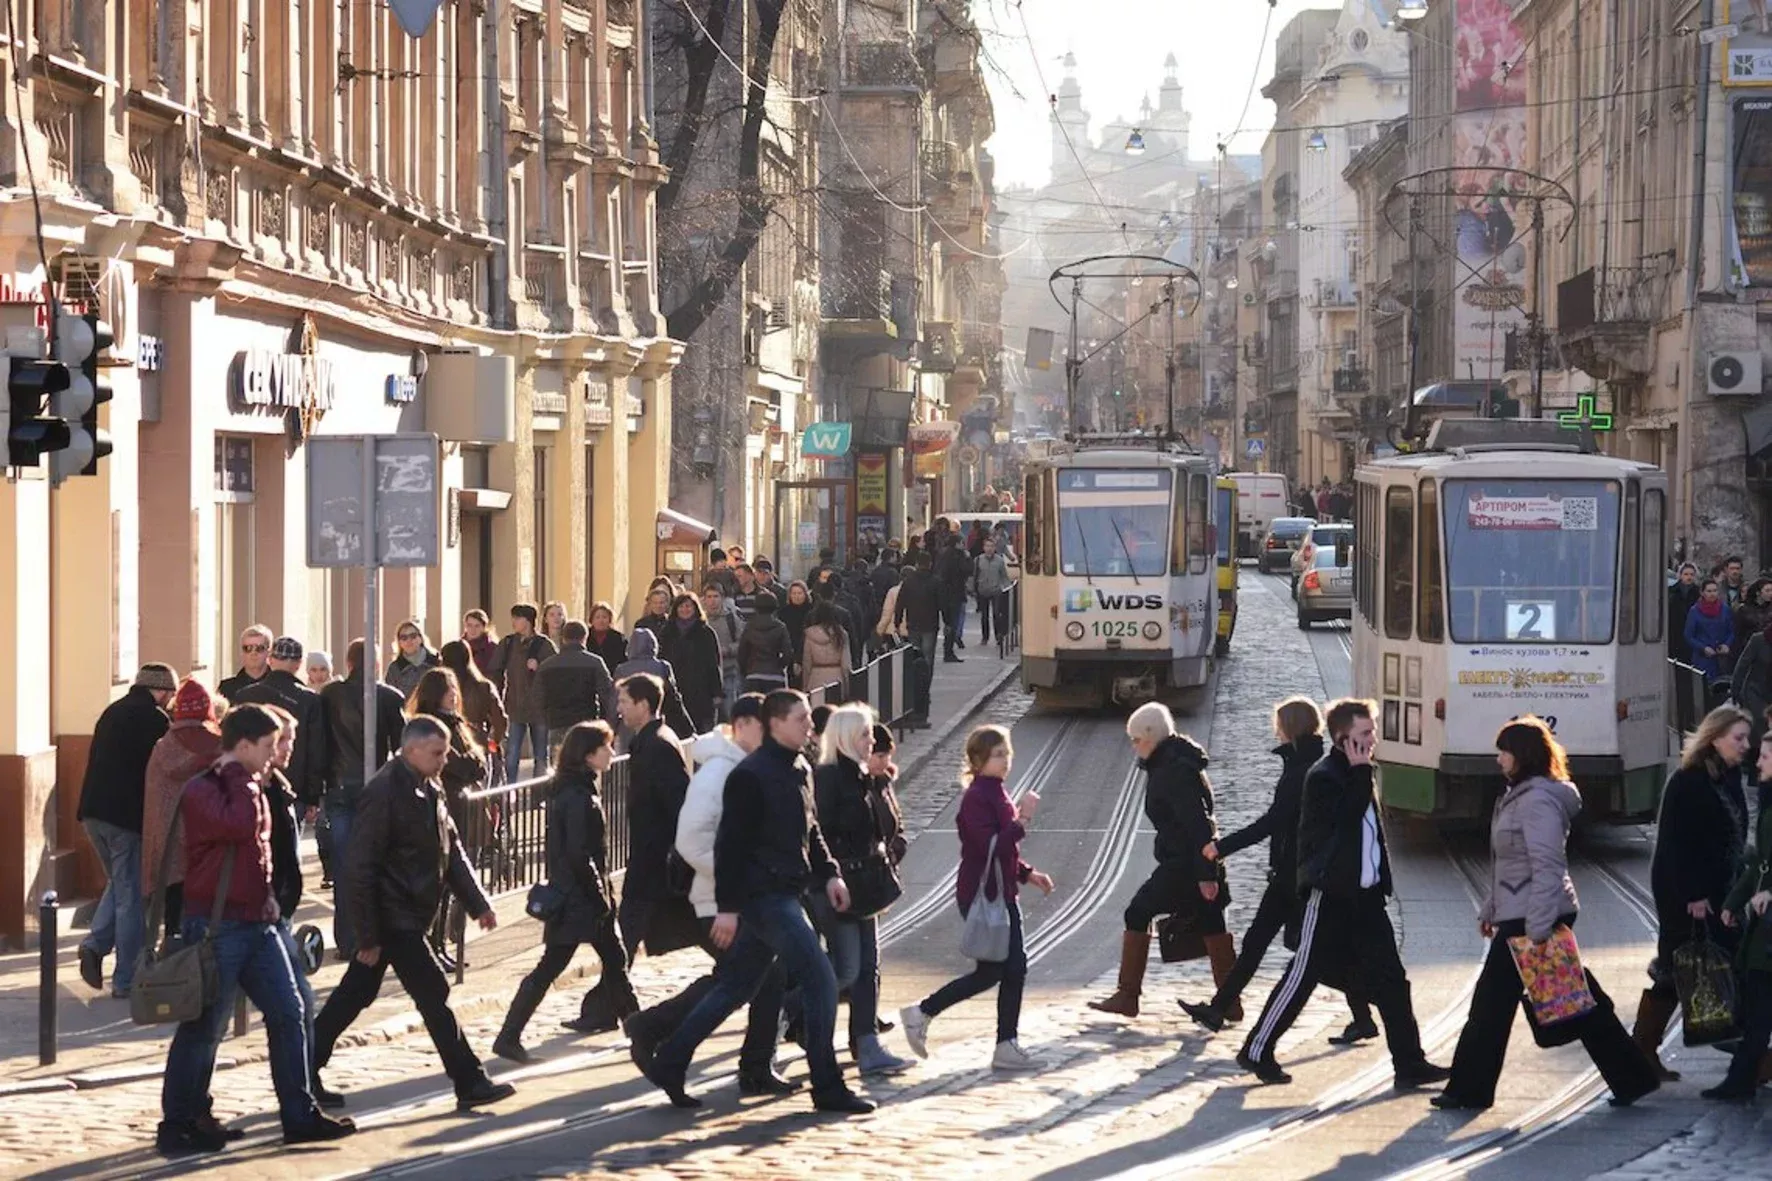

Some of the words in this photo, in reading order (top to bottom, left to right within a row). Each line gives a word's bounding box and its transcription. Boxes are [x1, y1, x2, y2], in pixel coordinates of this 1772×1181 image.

[1475, 501, 1527, 512] АРТПРОМ
[1096, 589, 1163, 610] WDS
[1518, 603, 1541, 638] 2
[1092, 621, 1138, 637] 1025
[1482, 648, 1513, 656] Винос
[1516, 649, 1550, 658] кузова
[1544, 691, 1590, 699] ЕЛЕКТРИКА
